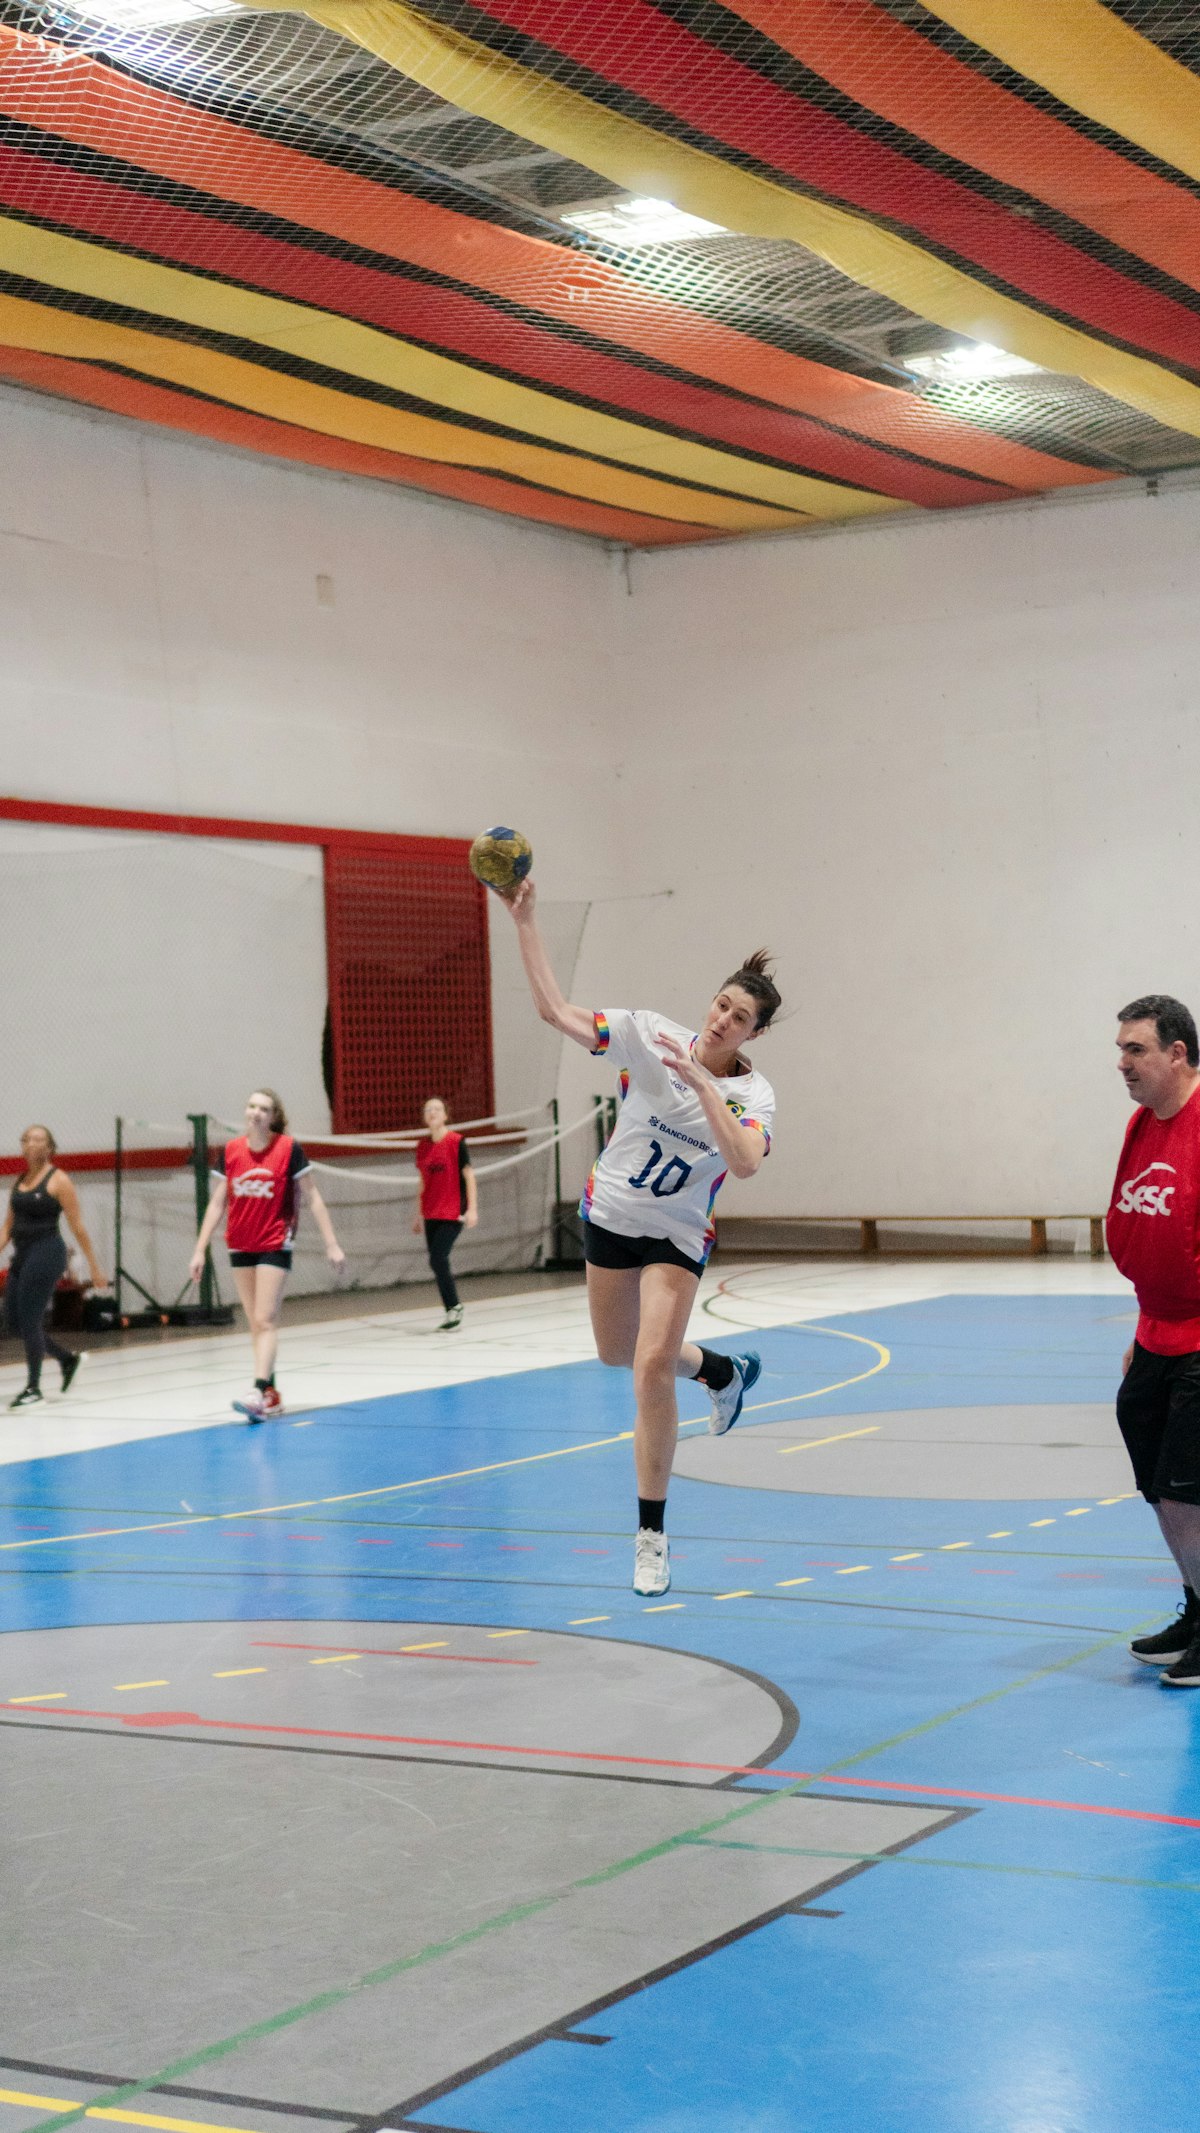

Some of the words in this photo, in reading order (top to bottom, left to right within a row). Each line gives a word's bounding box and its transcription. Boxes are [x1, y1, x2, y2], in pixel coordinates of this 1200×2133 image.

[659, 1123, 688, 1142] BANCO
[687, 1137, 699, 1147] DO
[628, 1140, 692, 1197] 10
